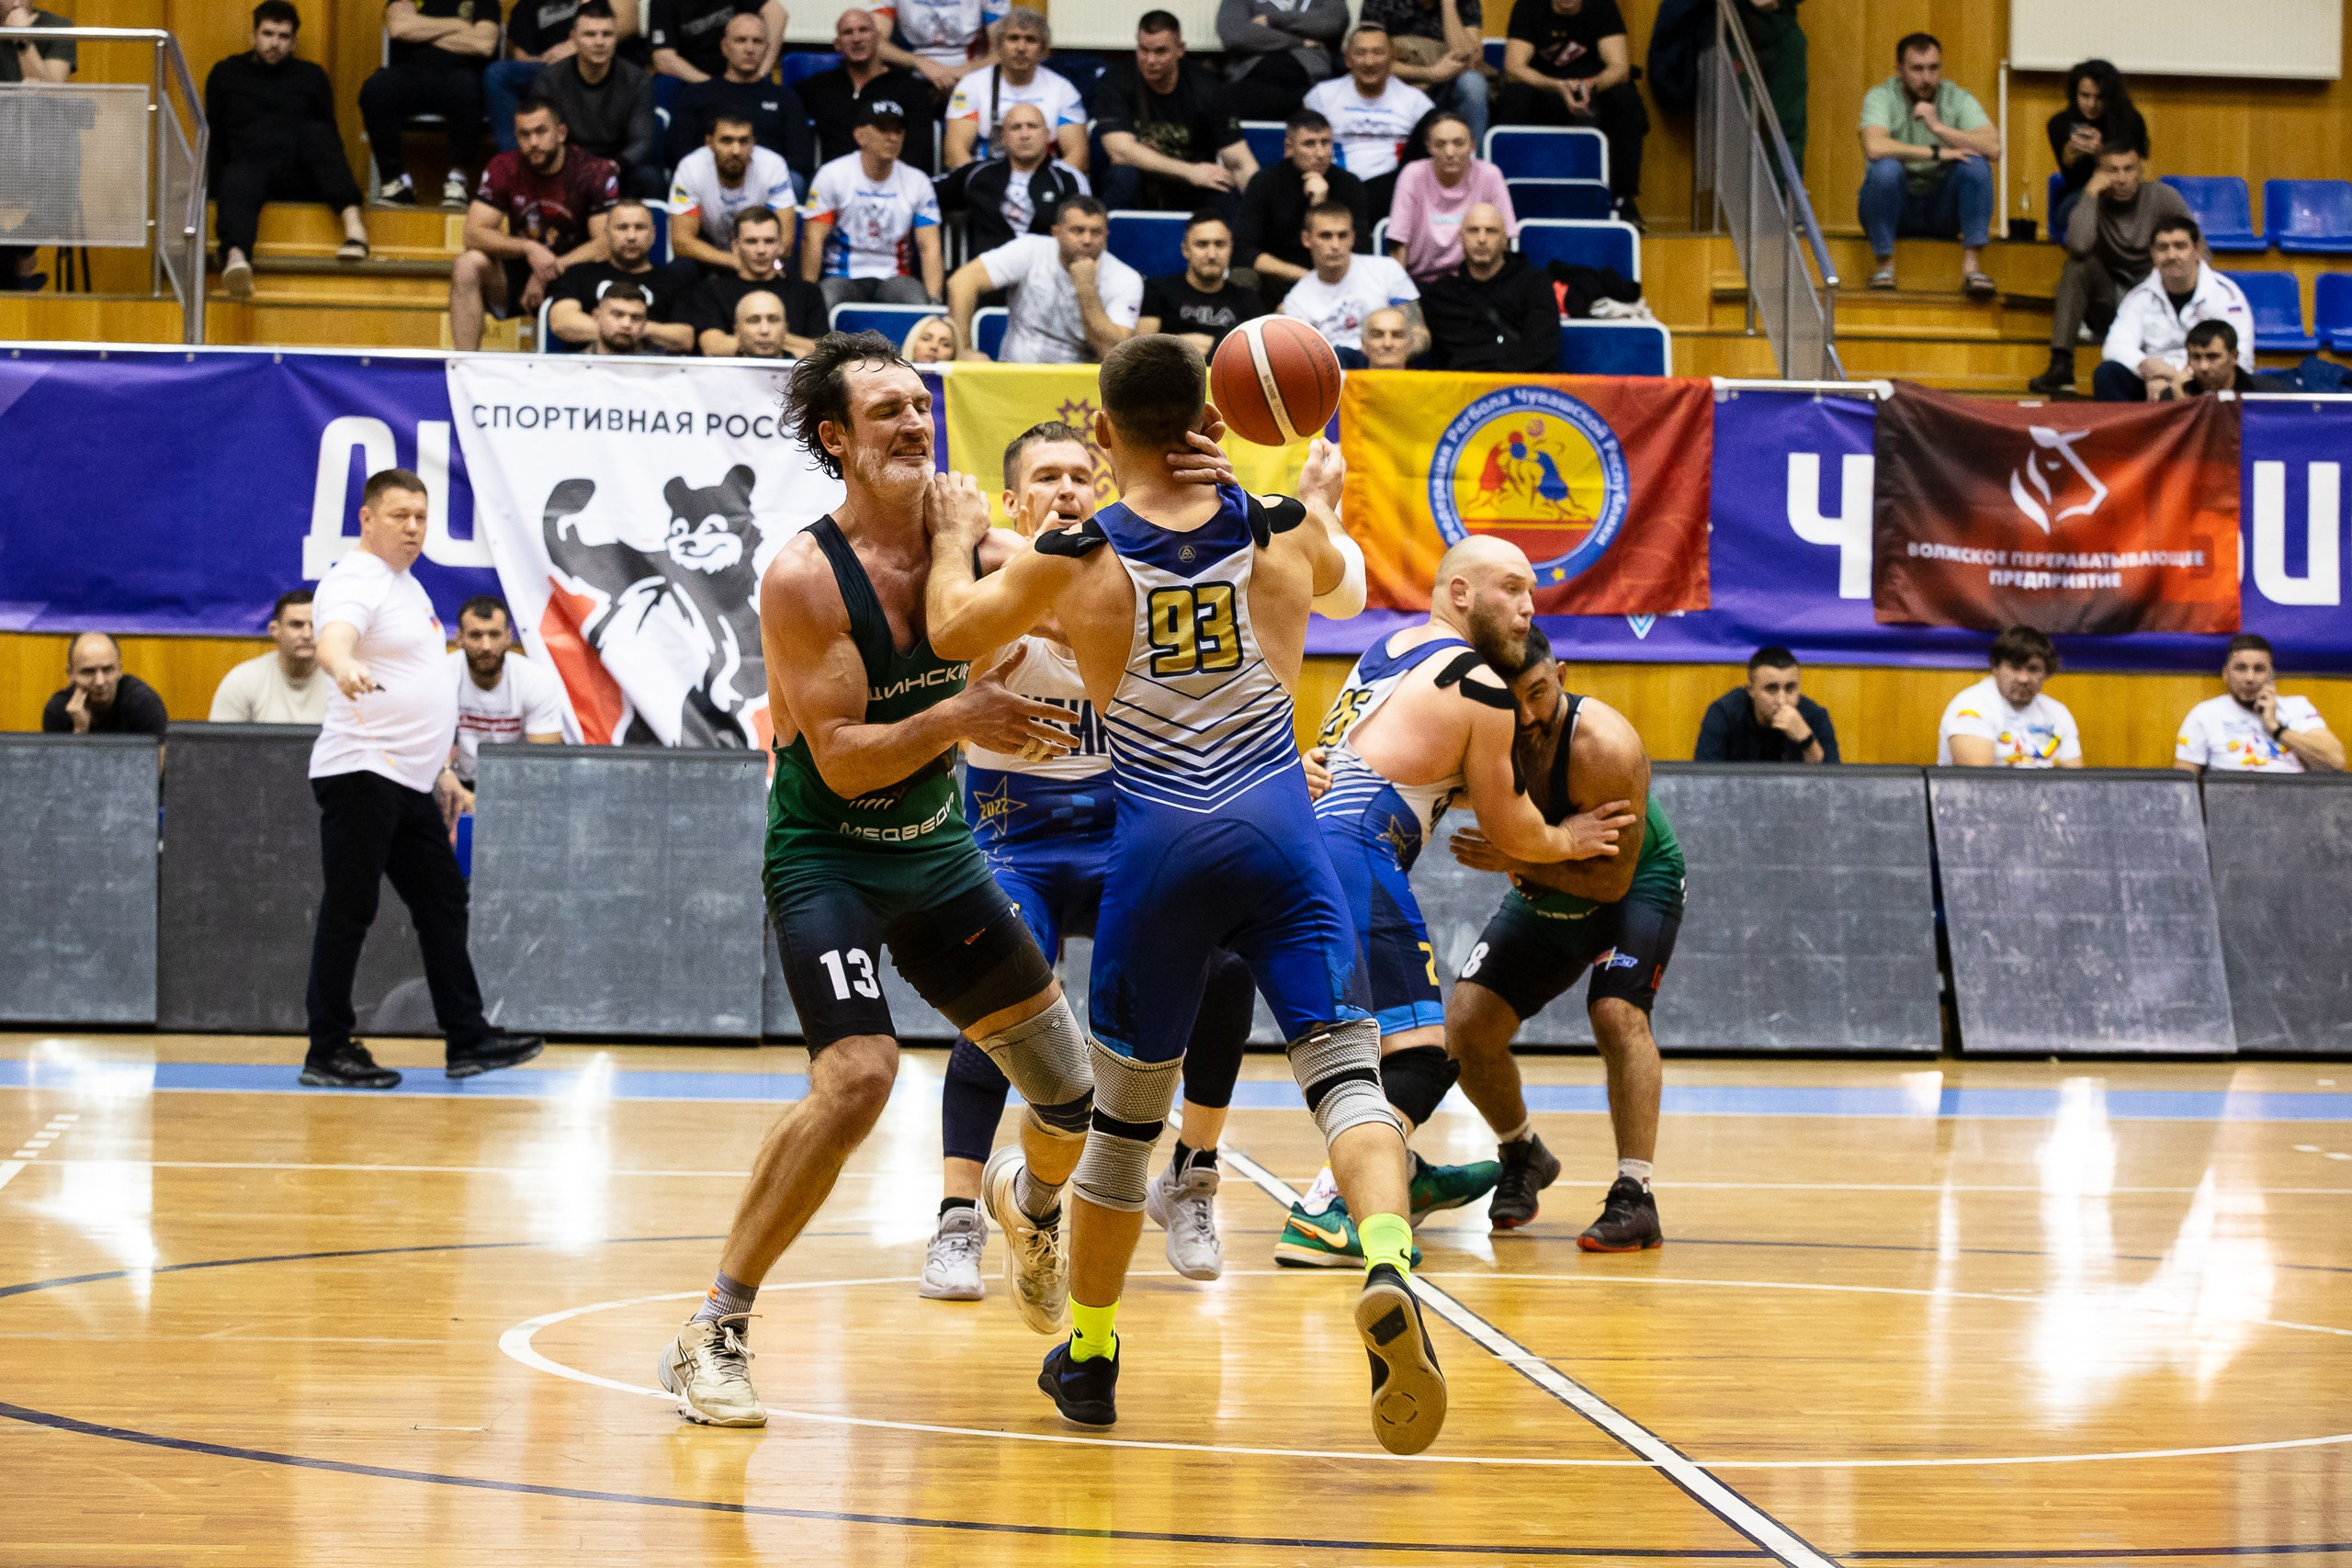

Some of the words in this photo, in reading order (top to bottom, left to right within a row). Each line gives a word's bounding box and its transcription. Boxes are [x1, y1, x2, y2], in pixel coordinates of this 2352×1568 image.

[472, 404, 693, 434] СПОРТИВНАЯ
[1906, 541, 2007, 567] ВОЛЖСКОЕ
[2010, 549, 2206, 570] ПЕРЕРАБАТЫВАЮЩЕЕ
[1988, 569, 2122, 591] ПРЕДПРИЯТИЕ
[1148, 581, 1243, 678] 93
[979, 796, 1010, 819] 2022
[820, 947, 880, 999] 13
